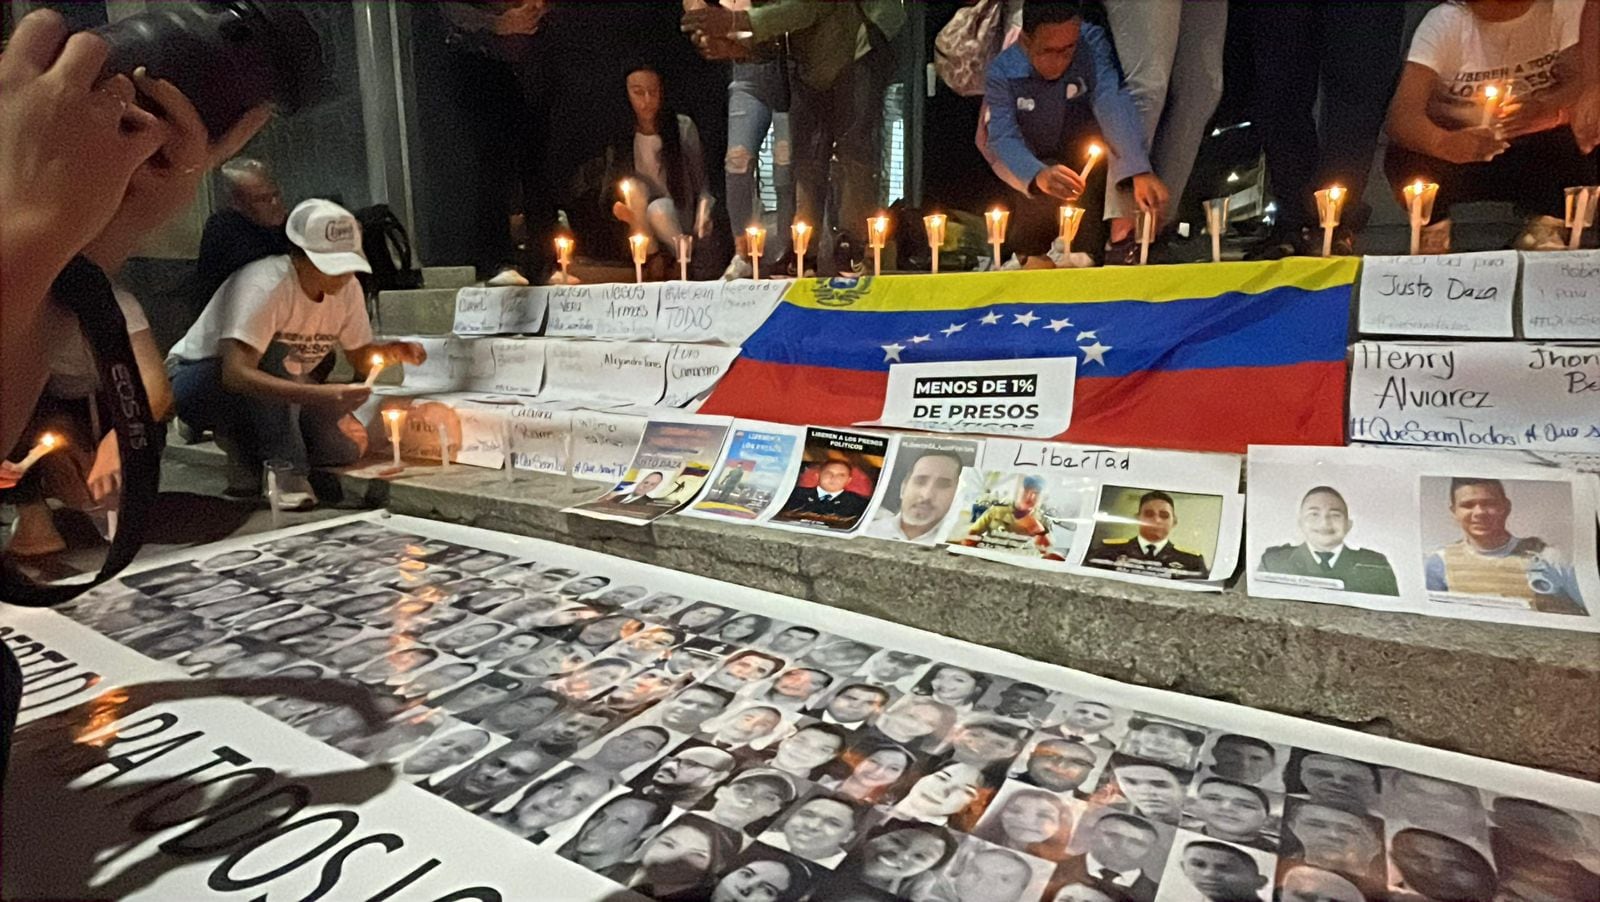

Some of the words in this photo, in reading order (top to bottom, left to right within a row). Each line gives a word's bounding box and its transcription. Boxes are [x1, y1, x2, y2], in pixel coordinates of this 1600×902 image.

[1378, 274, 1433, 298] Justo
[1447, 277, 1498, 300] Daza
[665, 304, 713, 332] TODOS
[1362, 344, 1454, 380] Henry
[916, 380, 978, 395] MENOS
[981, 379, 1007, 393] DE
[1011, 378, 1034, 393] 1%
[1374, 375, 1494, 411] Alviarez
[913, 404, 943, 419] DE
[948, 403, 1039, 420] PRESOS
[811, 430, 838, 440] LIBEREN
[844, 435, 857, 443] LOS
[857, 437, 884, 447] PRESOS
